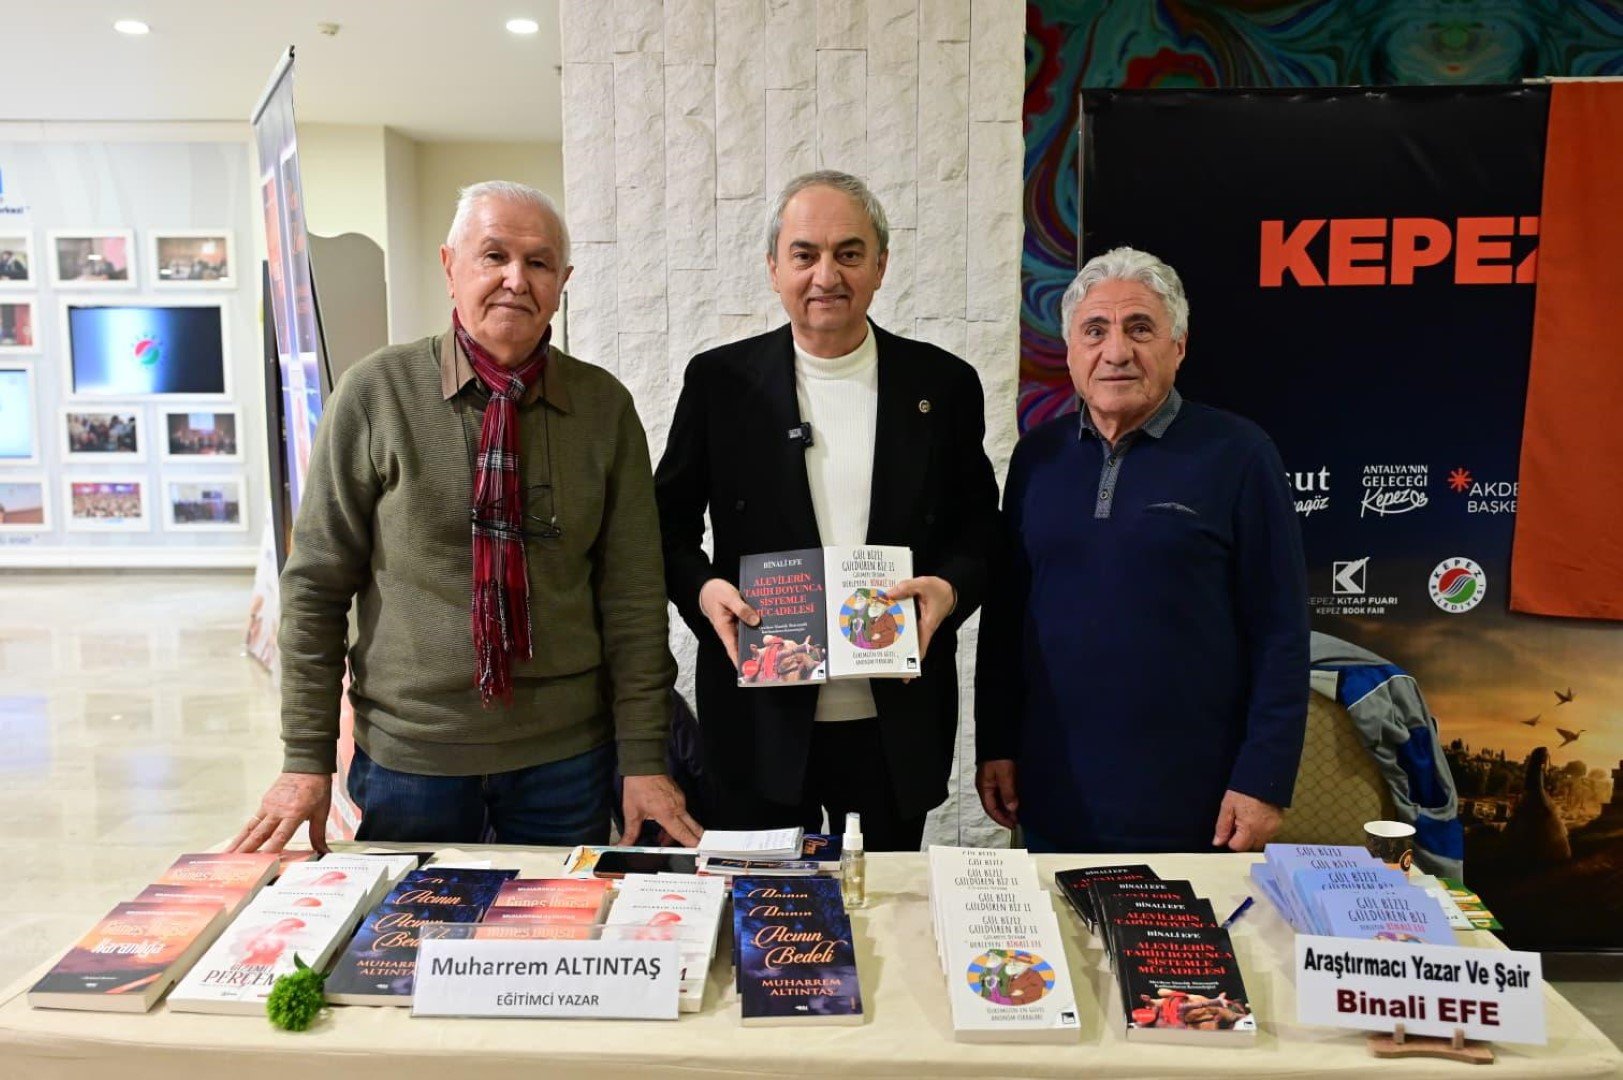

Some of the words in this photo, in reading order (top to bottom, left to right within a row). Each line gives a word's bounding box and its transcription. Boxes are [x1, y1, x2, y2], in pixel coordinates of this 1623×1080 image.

[1363, 465, 1428, 474] ANTALYA'NIN
[1286, 465, 1330, 491] ut
[1469, 482, 1520, 496] AKDE
[1294, 495, 1330, 517] agöz
[1361, 487, 1415, 518] Kepez
[1467, 500, 1517, 515] BAŞKE
[1434, 559, 1483, 578] KEPEZ
[1308, 597, 1337, 605] EPEZ
[1343, 607, 1366, 615] BOOK
[1367, 607, 1386, 615] FAIR
[750, 925, 823, 949] Acının
[1147, 930, 1180, 939] BİNALİ
[1181, 931, 1201, 939] EFE
[1136, 941, 1216, 951] ALEVİLERİN
[765, 939, 849, 970] Bedeli
[356, 959, 418, 968] MUHARR
[431, 956, 548, 976] Muharrem
[554, 957, 661, 979] ALTINTAŞ
[1146, 958, 1213, 967] SİSTEMLE
[360, 968, 417, 976] ALTINTA
[1304, 947, 1407, 979] Araştırmacı
[1411, 955, 1461, 983] Yazar
[1465, 960, 1489, 985] Ve
[1495, 963, 1531, 993] Şair
[762, 978, 841, 987] MUHARREM
[497, 992, 554, 1006] EĞİTİMCİ
[558, 994, 599, 1006] YAZAR
[1336, 988, 1426, 1020] Binali
[1438, 997, 1500, 1027] EFE
